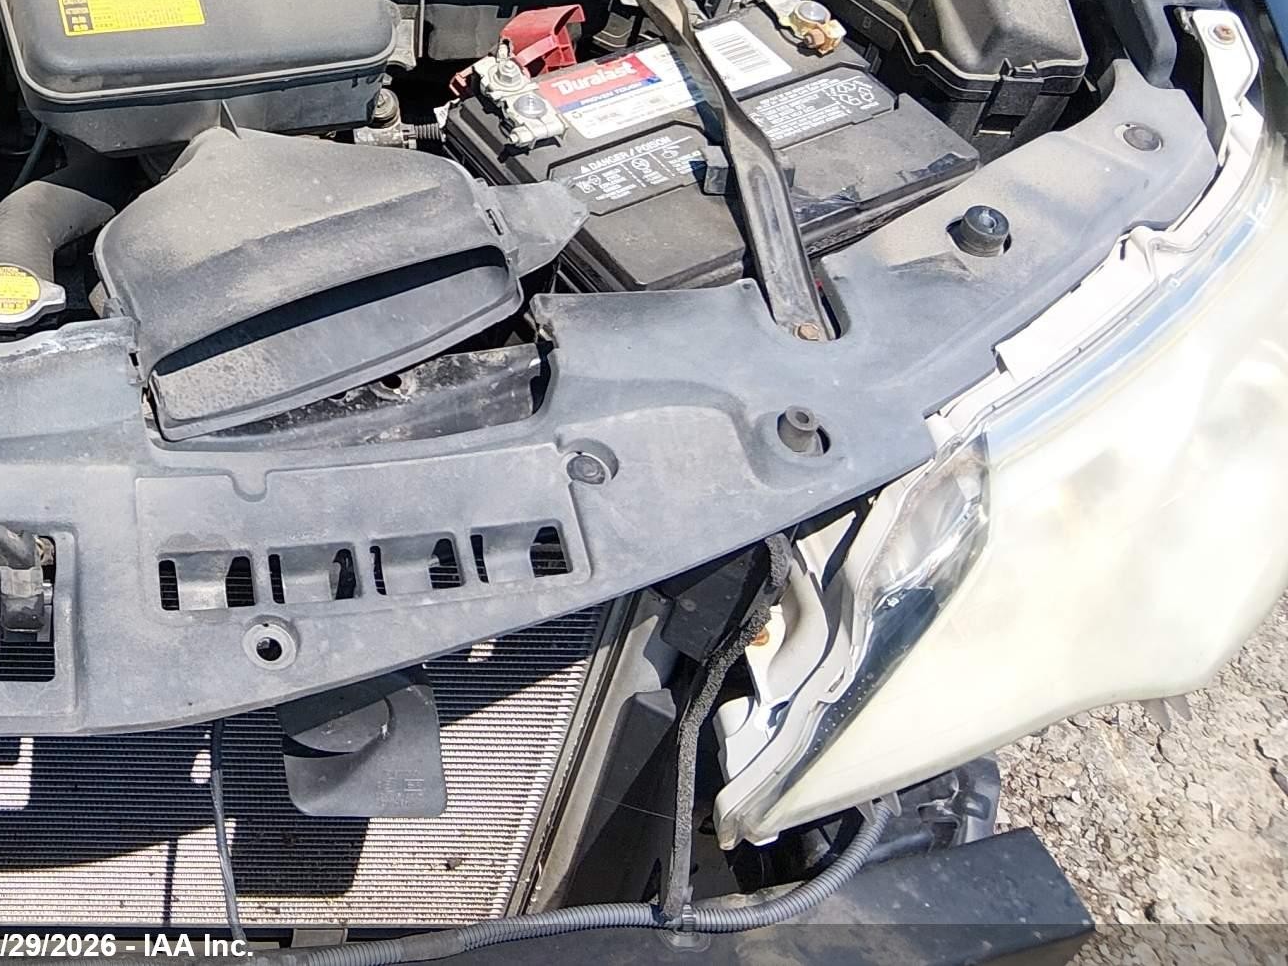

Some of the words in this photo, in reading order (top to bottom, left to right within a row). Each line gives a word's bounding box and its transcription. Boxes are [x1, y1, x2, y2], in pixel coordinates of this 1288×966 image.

[551, 60, 637, 95] Duralast
[588, 151, 629, 171] DANGER
[636, 136, 673, 154] POISON
